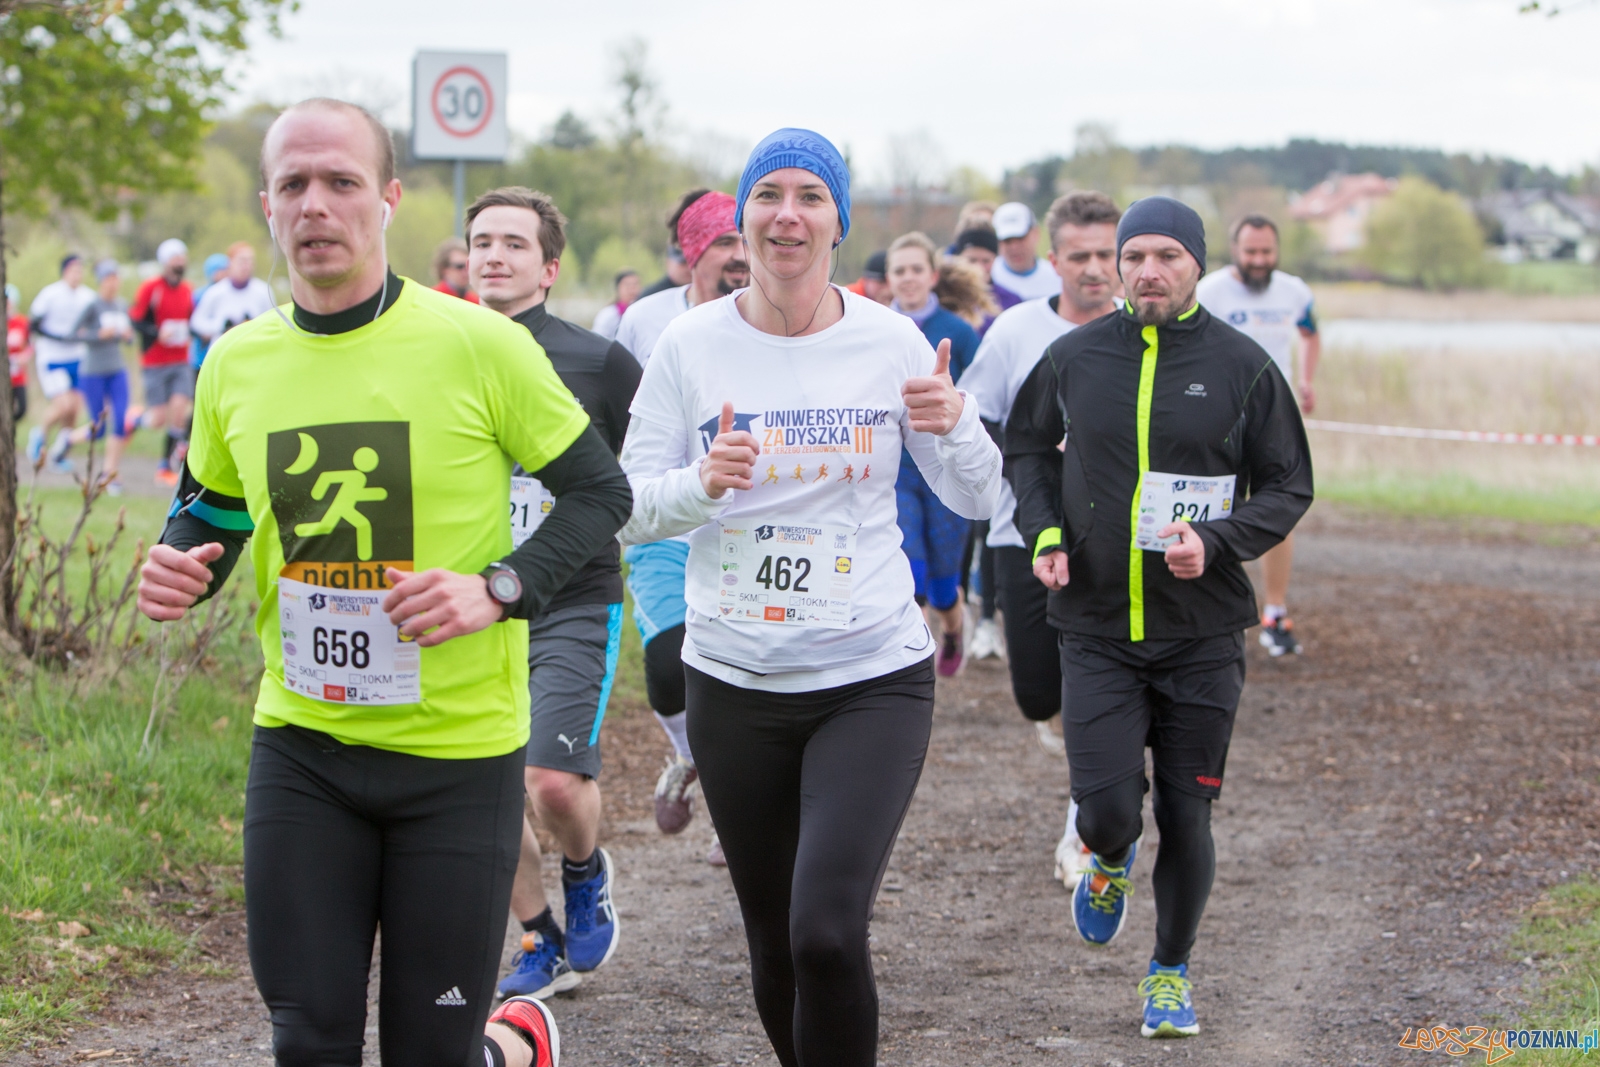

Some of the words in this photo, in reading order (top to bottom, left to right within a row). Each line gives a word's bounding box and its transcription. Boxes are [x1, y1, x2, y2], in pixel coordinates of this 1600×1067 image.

[442, 85, 484, 119] 30
[764, 408, 888, 427] UNIWERSYTECKA
[763, 427, 850, 446] ZADYSZKA
[855, 427, 873, 454] III
[774, 446, 800, 455] JERZEGO
[776, 531, 806, 541] ZADYSZKA
[777, 525, 822, 536] UNIWERSYTECKA
[303, 562, 387, 590] night
[755, 555, 811, 593] 462
[329, 594, 379, 605] UNIWERSYTECKA
[739, 592, 758, 602] 5KM
[801, 597, 827, 608] 10KM
[313, 626, 370, 669] 658
[299, 665, 316, 678] 5KM
[362, 674, 393, 684] 10KM
[435, 997, 467, 1006] adidas
